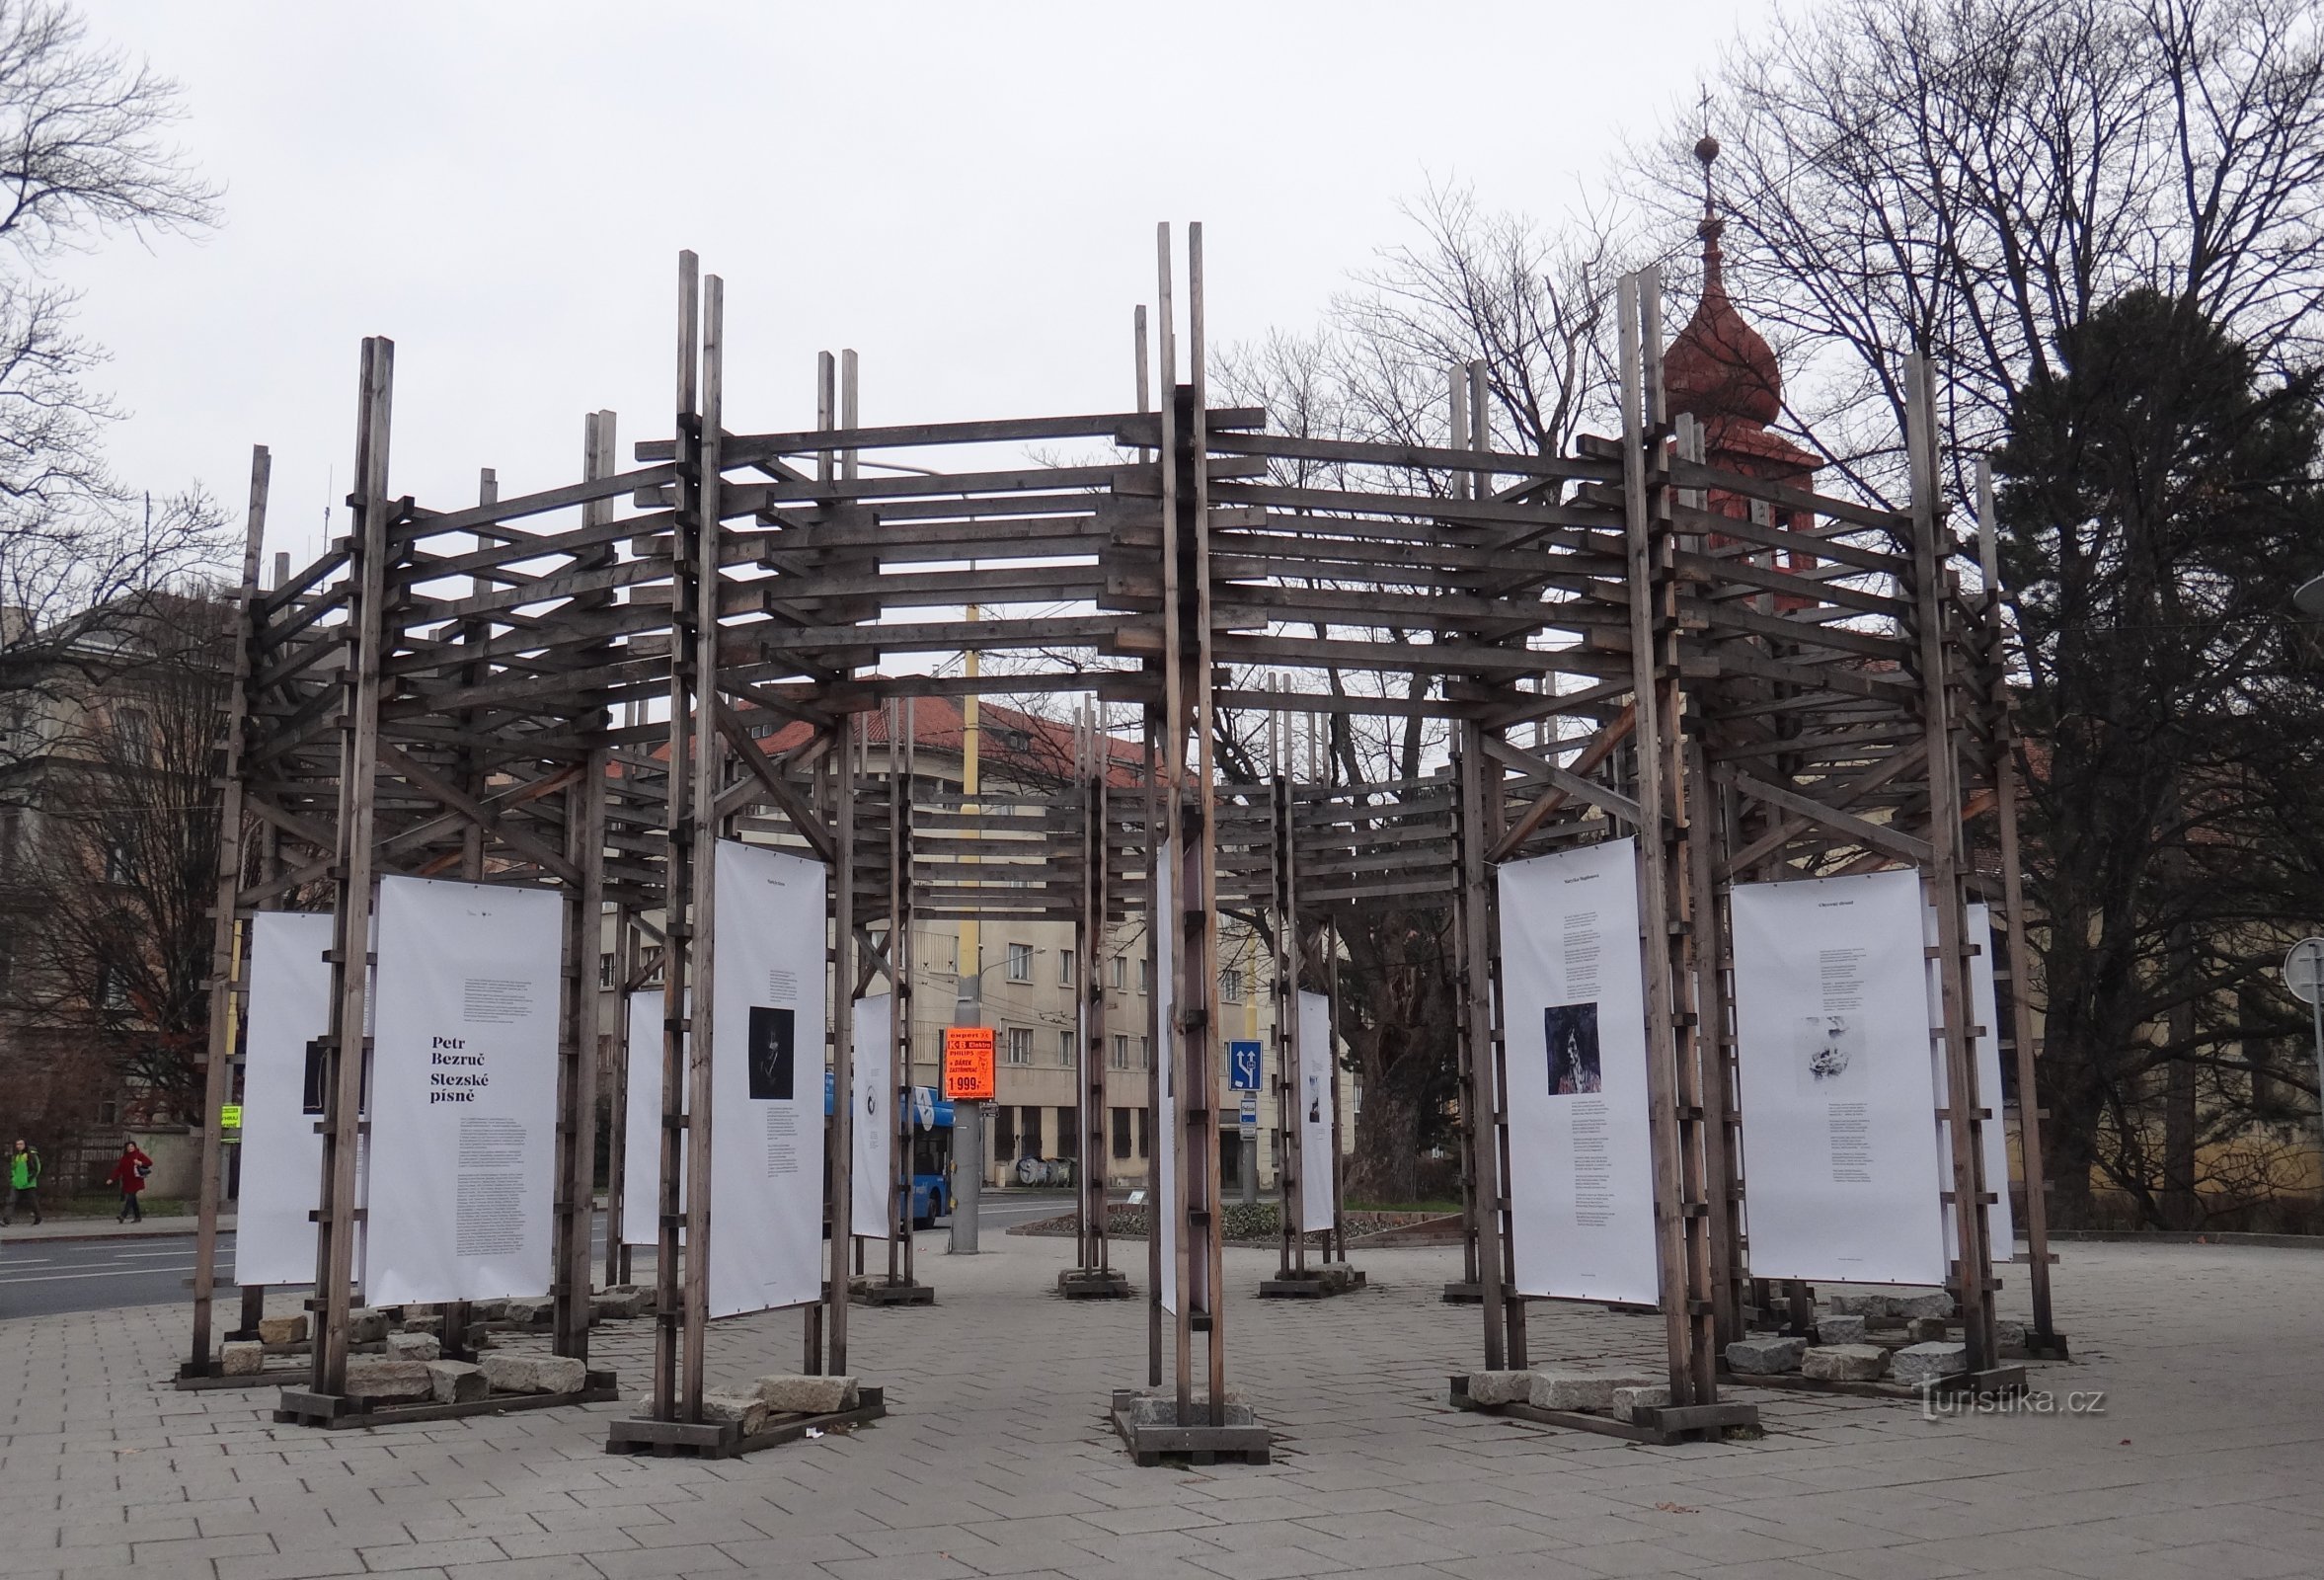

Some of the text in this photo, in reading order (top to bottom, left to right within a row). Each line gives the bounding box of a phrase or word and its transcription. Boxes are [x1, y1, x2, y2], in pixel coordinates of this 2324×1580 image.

[432, 1036, 465, 1049] Petr
[431, 1053, 485, 1066] Bezruč
[430, 1072, 490, 1086] Slezské
[430, 1088, 475, 1104] písně
